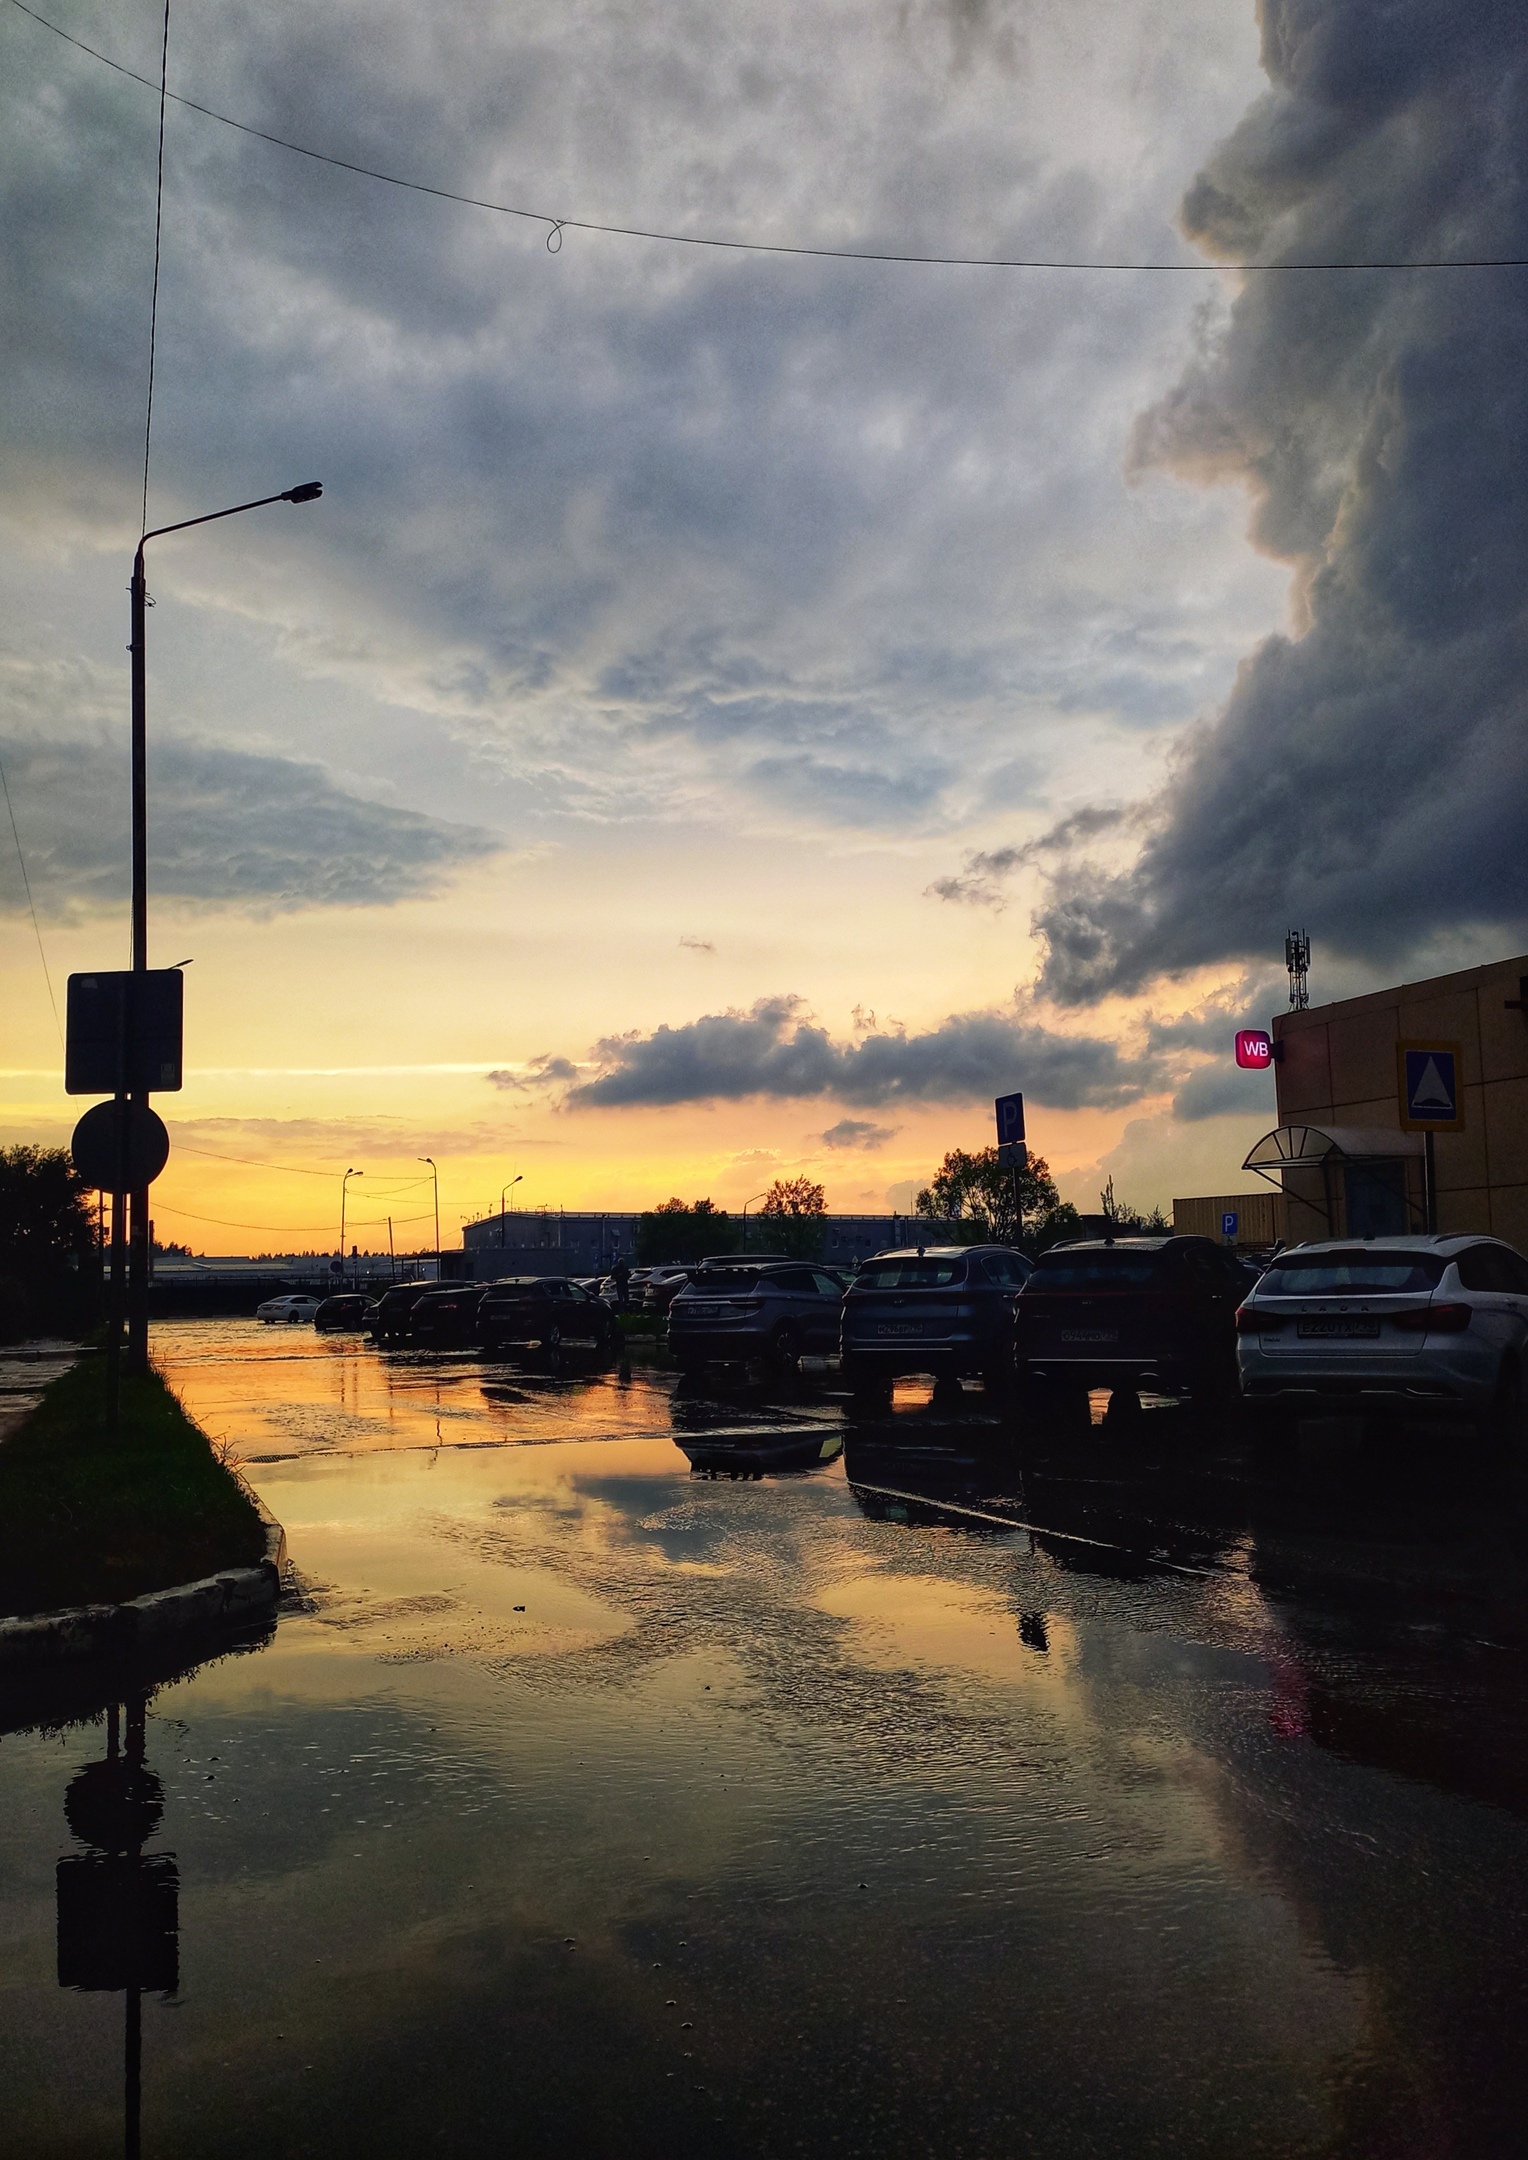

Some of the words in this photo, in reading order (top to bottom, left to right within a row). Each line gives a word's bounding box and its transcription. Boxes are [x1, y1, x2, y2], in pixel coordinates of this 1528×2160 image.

[1244, 1041, 1269, 1057] WB
[1003, 1101, 1018, 1139] P
[1225, 1215, 1234, 1233] P
